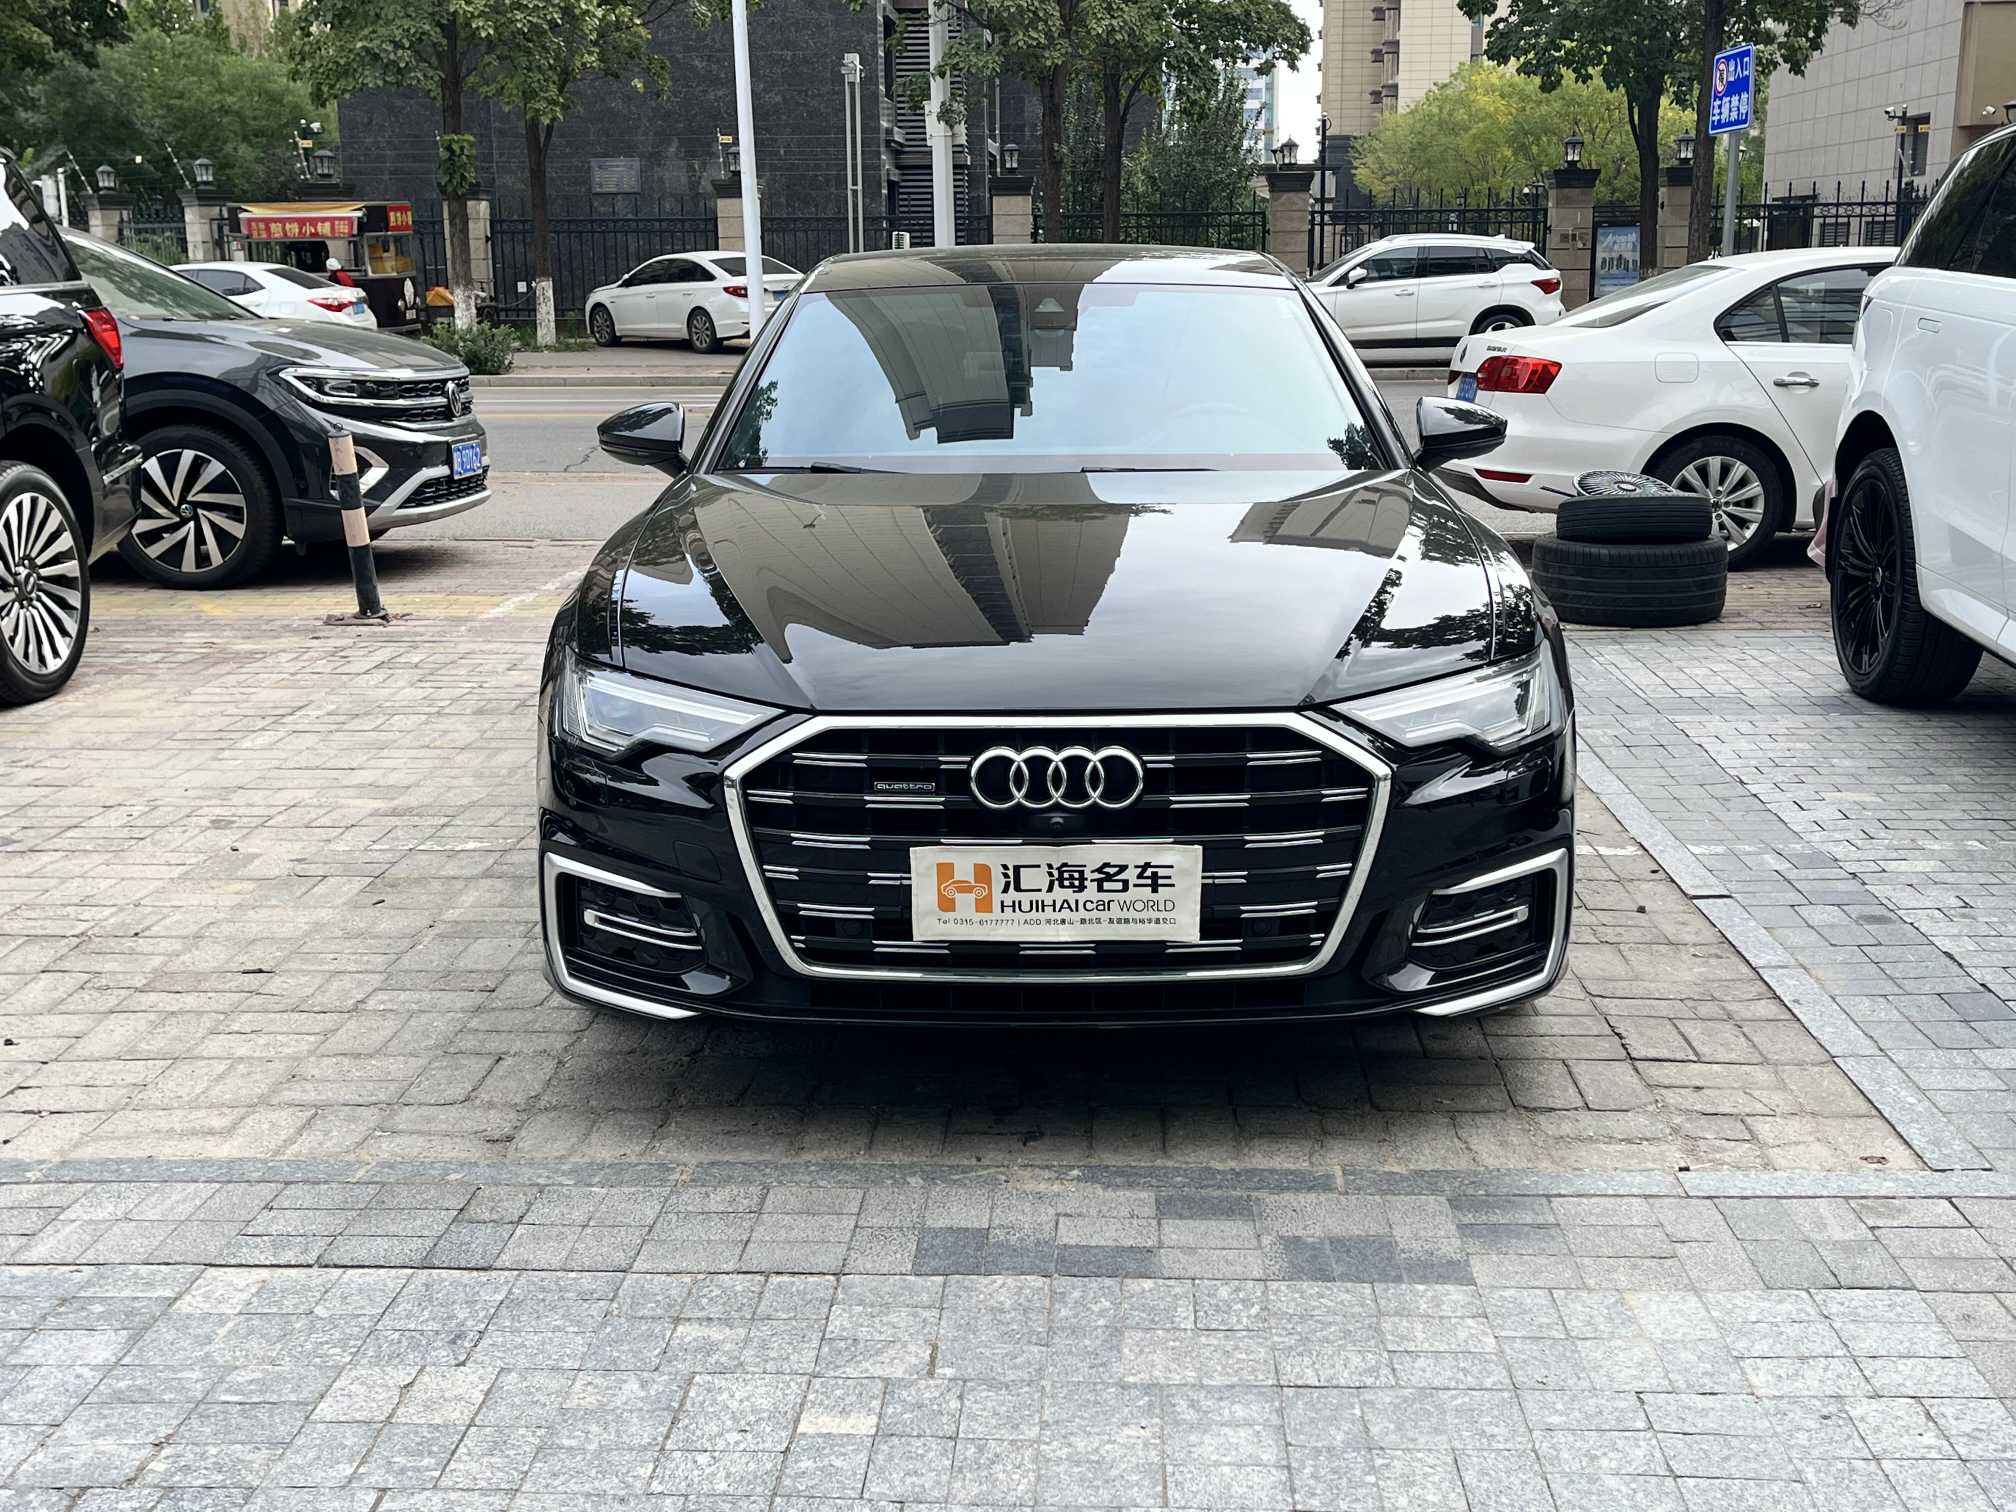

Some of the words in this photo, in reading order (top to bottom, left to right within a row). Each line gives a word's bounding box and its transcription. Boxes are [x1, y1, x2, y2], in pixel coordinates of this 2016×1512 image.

[1728, 56, 1750, 82] 出入口
[1711, 91, 1749, 126] 车辆禁停
[1000, 861, 1176, 894] 汇海名车
[1000, 899, 1079, 914] HUIHAI
[1083, 899, 1116, 912] car
[1117, 899, 1176, 913] WORLD
[1023, 918, 1042, 926] ADD
